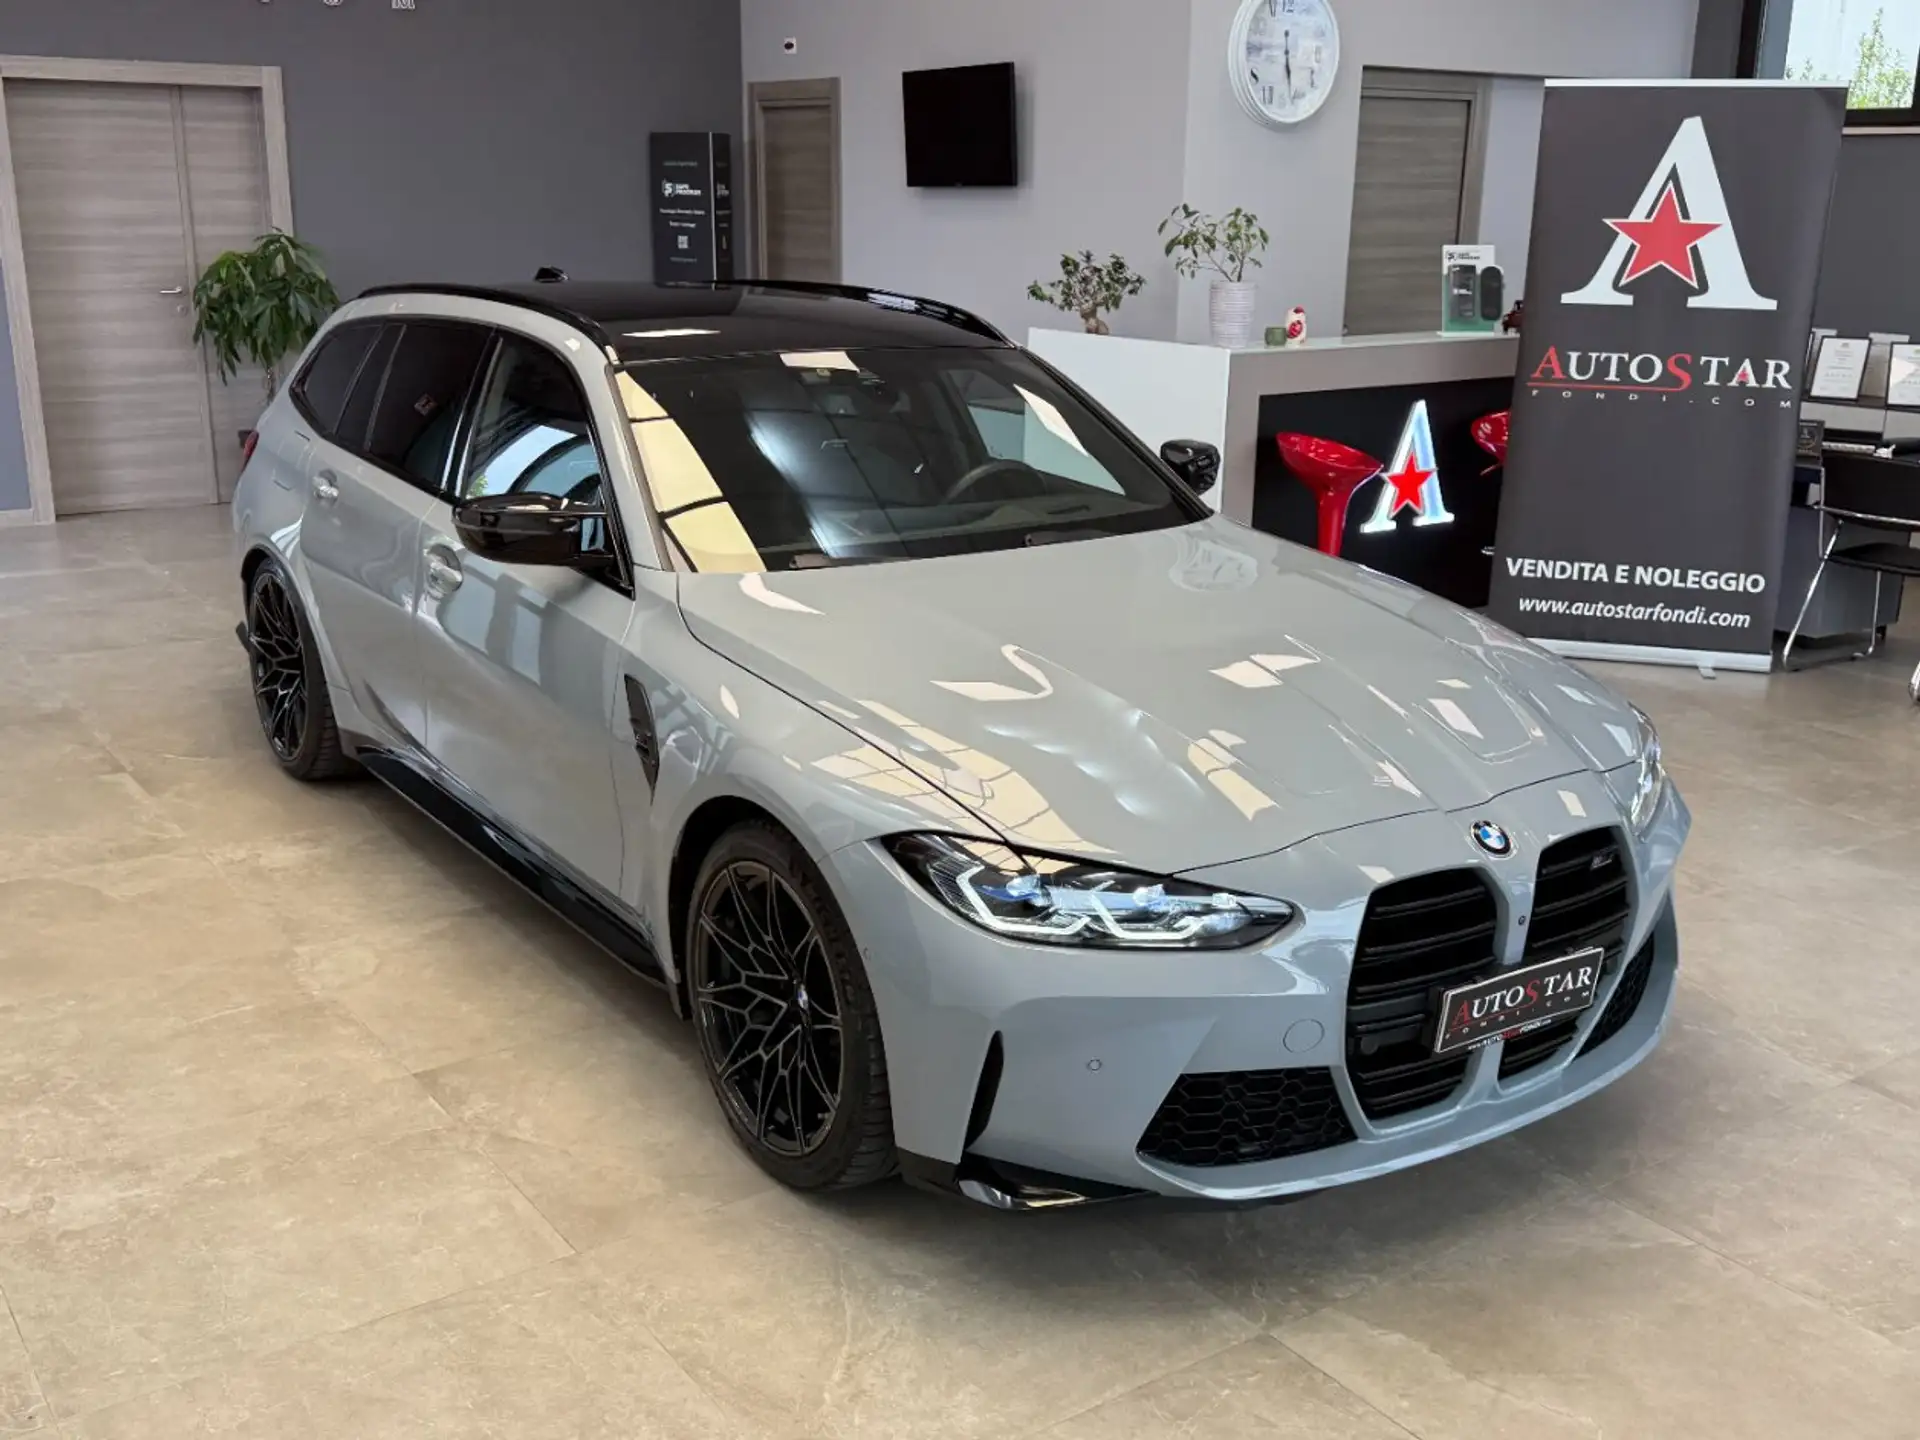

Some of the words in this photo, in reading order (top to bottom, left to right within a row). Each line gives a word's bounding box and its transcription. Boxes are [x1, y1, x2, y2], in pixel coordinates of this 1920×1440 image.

[1506, 557, 1608, 582] VENDITA
[1614, 564, 1630, 584] E
[1634, 566, 1765, 593] NOLEGGIO
[1518, 597, 1750, 628] www.autostarfondi.com
